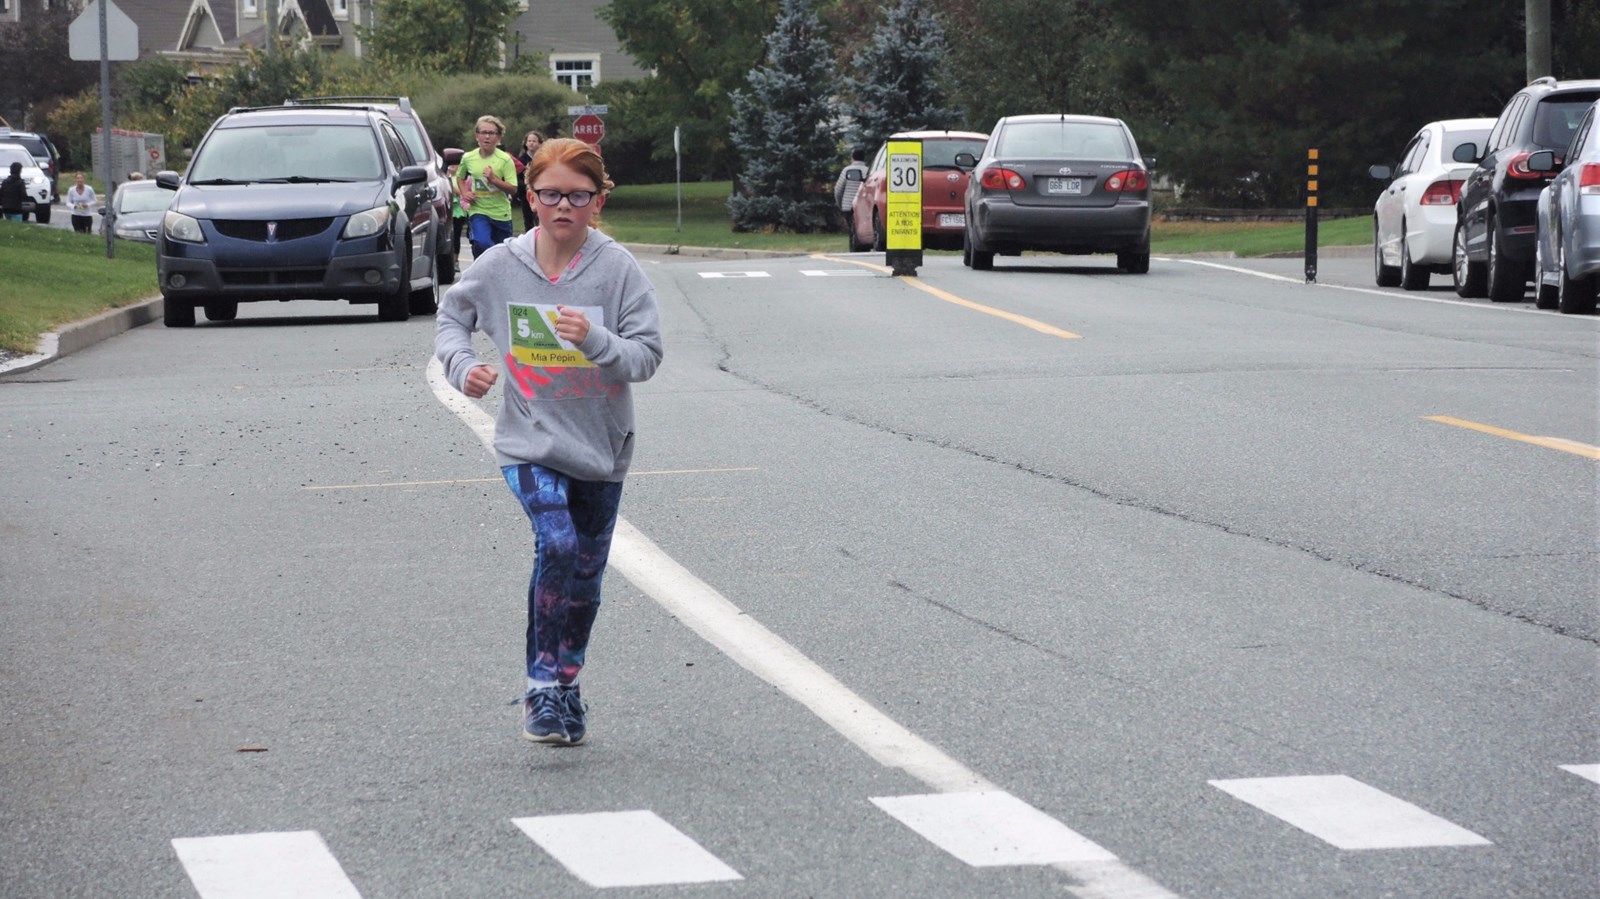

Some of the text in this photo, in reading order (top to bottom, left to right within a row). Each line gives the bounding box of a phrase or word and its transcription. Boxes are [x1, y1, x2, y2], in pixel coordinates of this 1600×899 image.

[893, 167, 916, 187] 30
[512, 308, 528, 317] 024
[517, 318, 545, 340] 5 km
[531, 352, 576, 364] Mia Pépin
